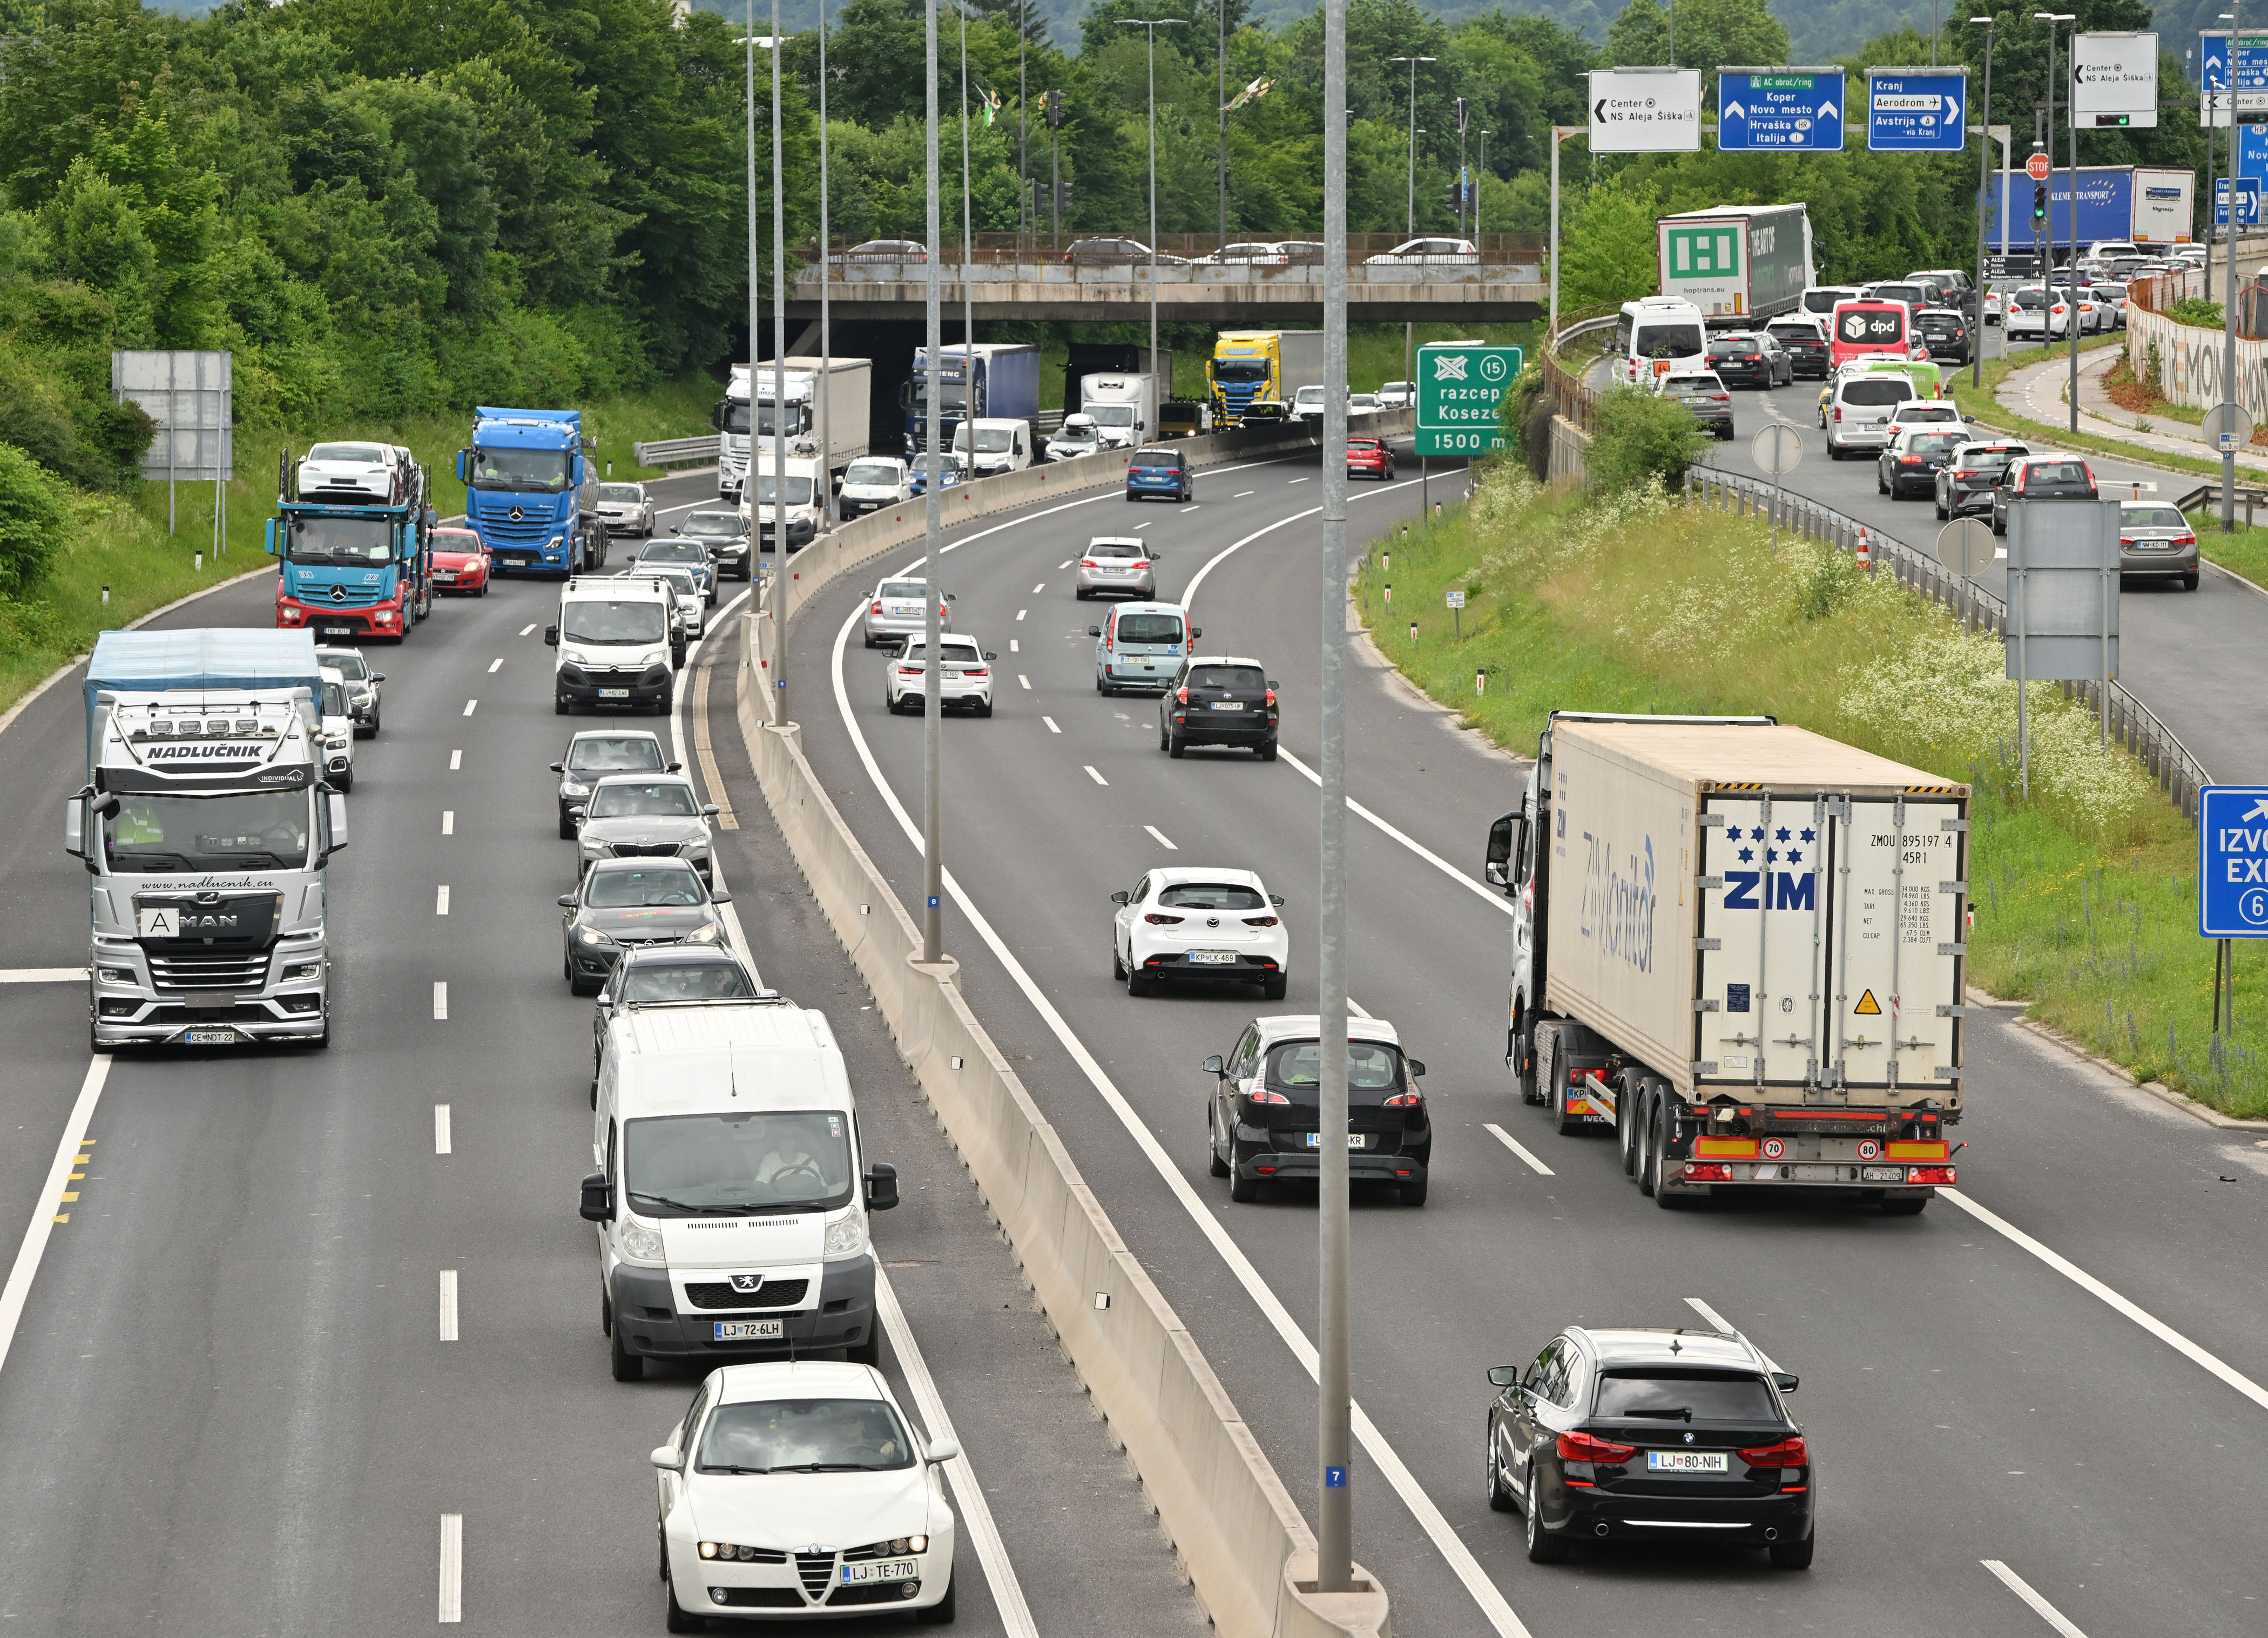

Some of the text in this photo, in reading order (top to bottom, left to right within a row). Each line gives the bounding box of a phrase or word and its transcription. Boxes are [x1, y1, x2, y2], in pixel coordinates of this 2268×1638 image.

[2228, 49, 2250, 57] Kper
[1776, 77, 1812, 87] obroč/ring
[1877, 81, 1902, 92] Kranj
[1611, 99, 1642, 107] Center
[1767, 92, 1796, 103] Koper
[1877, 98, 1924, 107] Aerodrom
[1750, 105, 1812, 114] Novo mesto
[1611, 110, 1682, 122] NS Aleja Šiška
[1750, 120, 1791, 129] Hrvaška
[1875, 117, 1915, 127] Avstrija
[1919, 128, 1935, 137] Kranj
[2254, 126, 2264, 134] HR
[1757, 133, 1786, 144] Italija
[2248, 151, 2268, 159] Nov
[2051, 191, 2109, 201] KLEME TRANSPORT
[1751, 226, 1774, 257] THE ART OF
[1871, 320, 1895, 334] dpd
[1487, 362, 1500, 373] 15
[1441, 388, 1500, 402] razcep
[1439, 405, 1500, 419] Koseze
[1434, 434, 1480, 448] 1500
[147, 743, 263, 759] NADLUČNIK
[1871, 835, 1951, 847] ZMOU 895197 4
[1902, 852, 1926, 864] 45R1
[141, 875, 273, 890] www.nadlucnik.eu
[1724, 871, 1815, 911] ZIM
[2252, 895, 2264, 916] 6
[150, 912, 238, 932] A MAN
[207, 1033, 233, 1041] NDT-22
[1574, 1089, 1584, 1098] KP
[1769, 1144, 1779, 1153] 70
[1863, 1146, 1874, 1154] 80
[724, 1323, 779, 1336] LJ 72-6LH
[1662, 1455, 1721, 1468] LJ 80-NIH
[1333, 1471, 1340, 1481] 7
[853, 1562, 913, 1580] LJ TE-770
